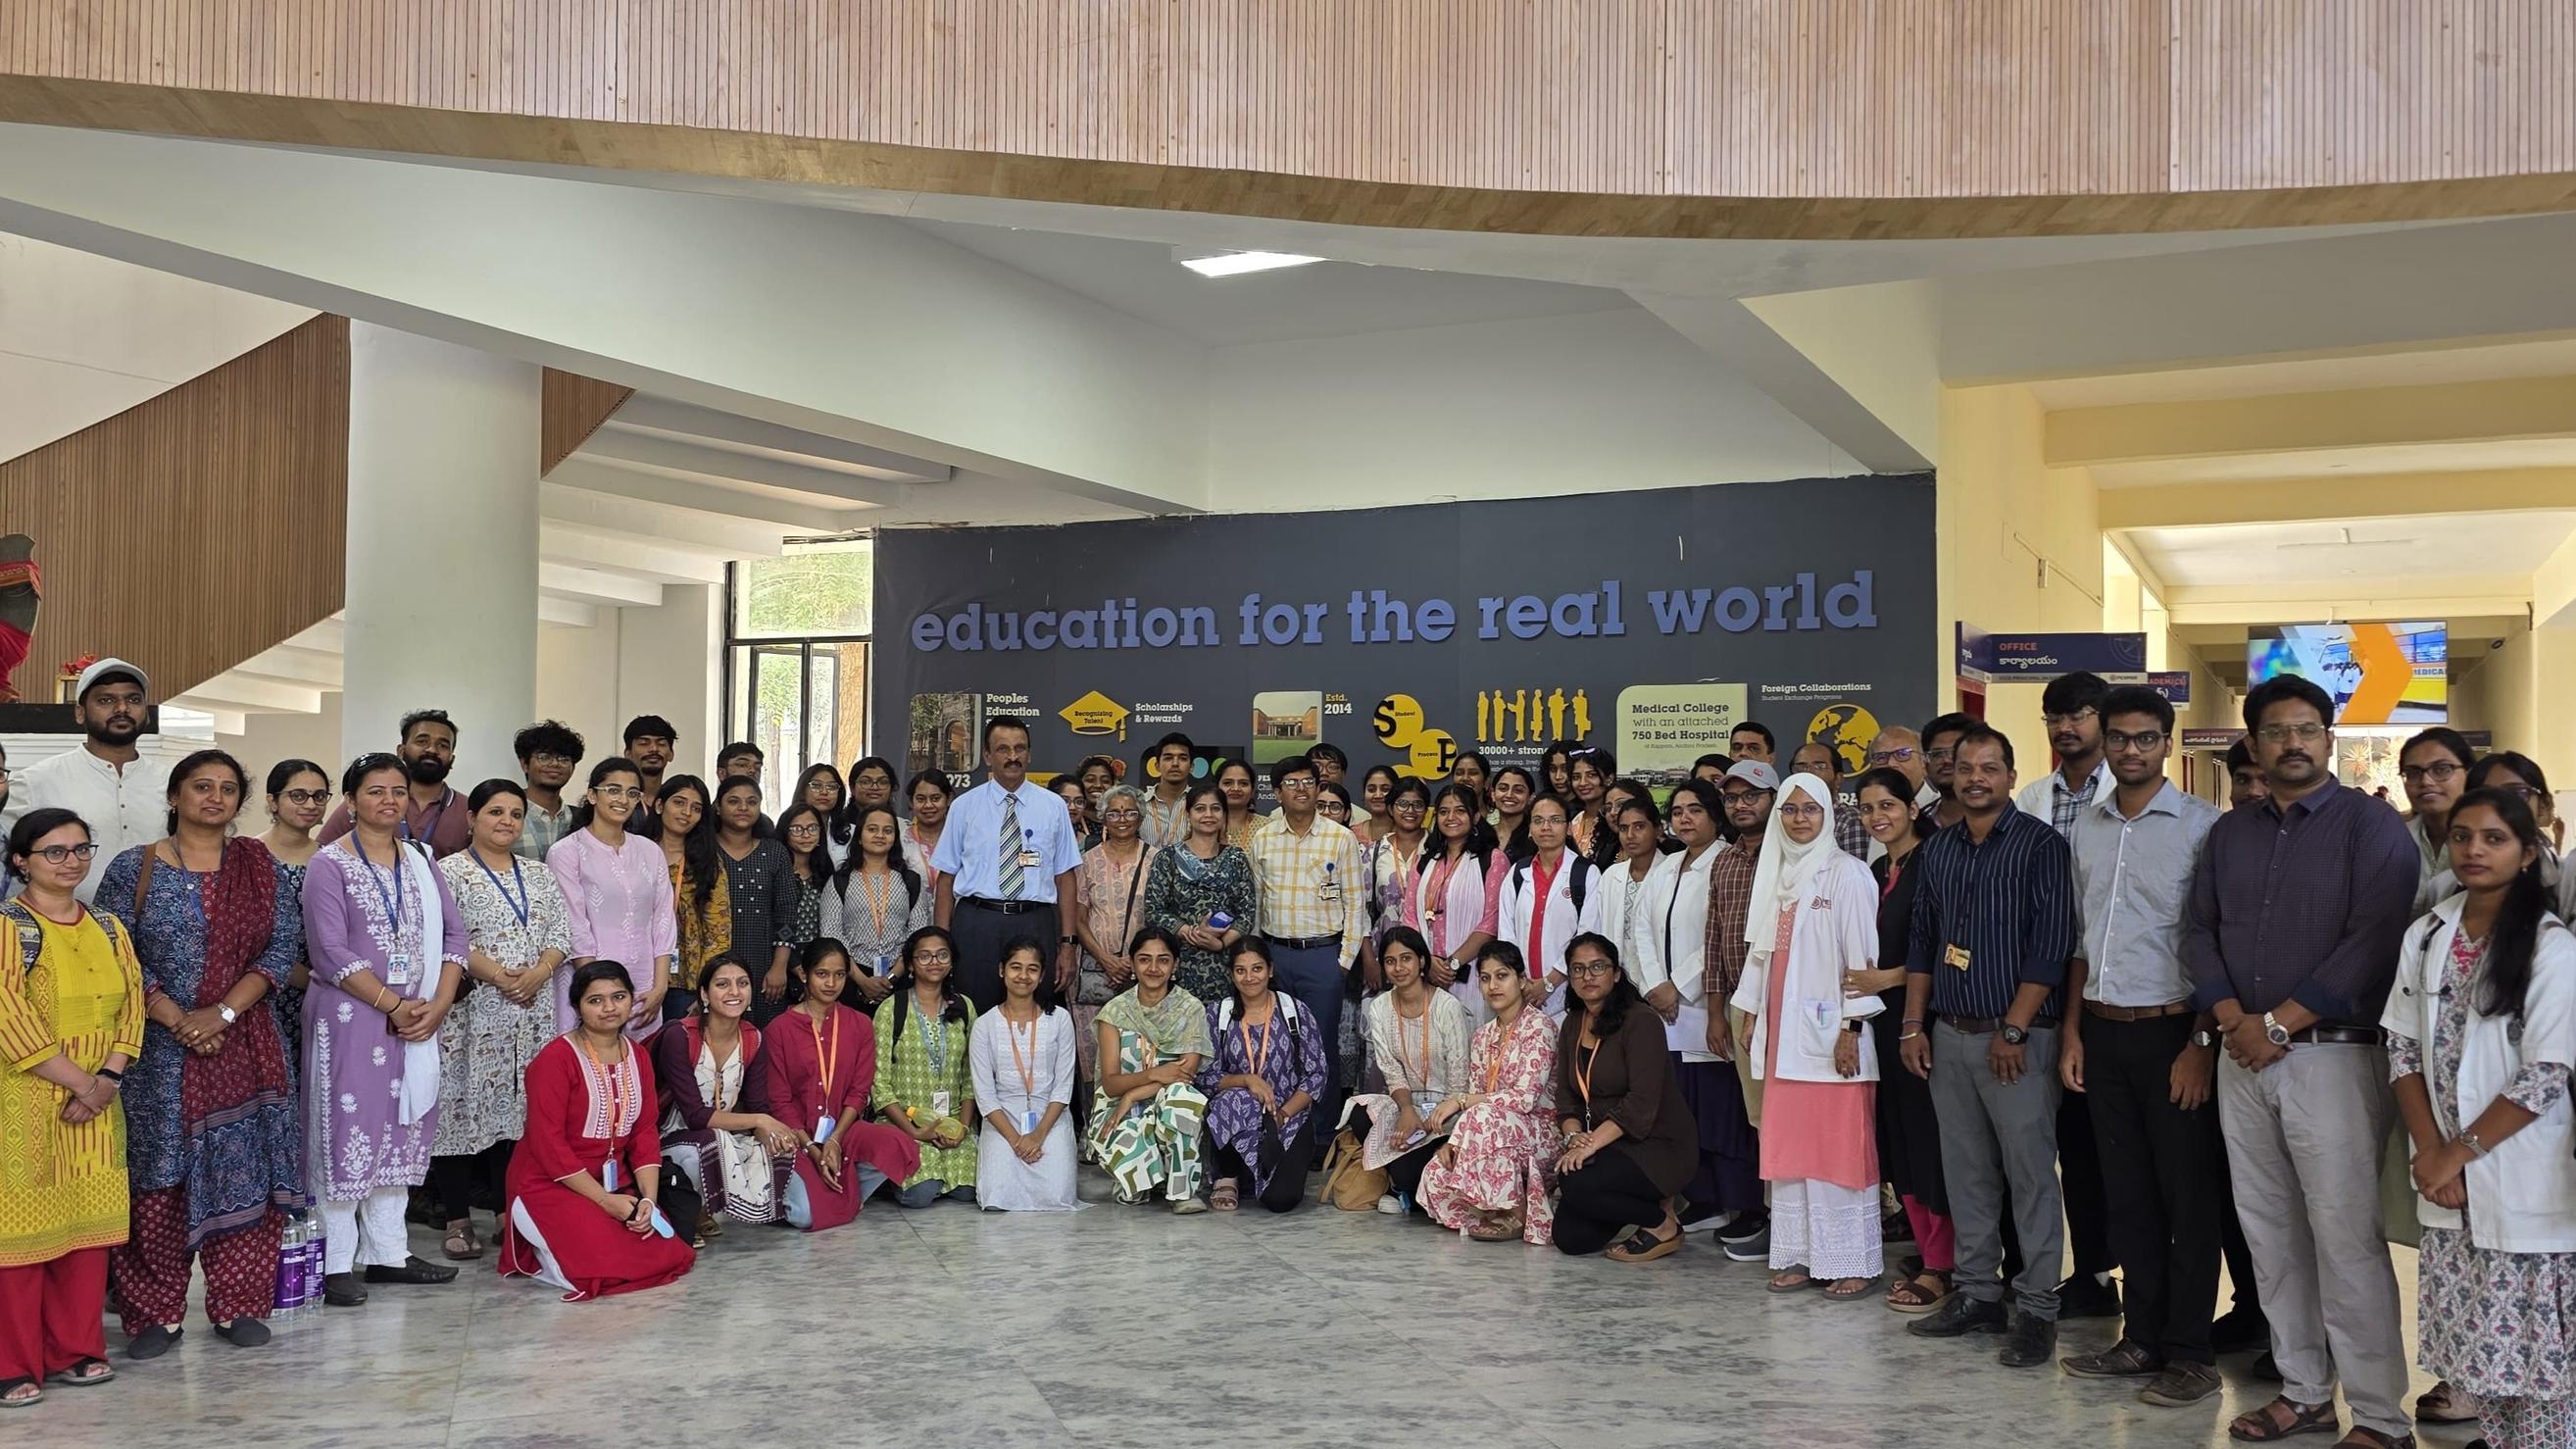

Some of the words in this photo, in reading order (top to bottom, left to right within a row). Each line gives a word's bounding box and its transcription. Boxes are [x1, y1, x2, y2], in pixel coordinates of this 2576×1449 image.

[911, 597, 1220, 652] education
[1238, 593, 1328, 646] for
[1347, 590, 1457, 644] the
[1478, 580, 1626, 639] real
[1647, 570, 1878, 634] world
[1999, 642, 2038, 651] OFFICE
[2413, 667, 2447, 675] EDICA
[1761, 684, 1798, 693] Foreign
[1800, 683, 1872, 692] Collaborations
[986, 693, 1029, 705] Peoples
[1325, 693, 1348, 702] Estd.
[986, 706, 1040, 717] Education
[1135, 702, 1194, 713] Scholarships
[1324, 703, 1353, 715] 2014
[1632, 705, 1680, 714] Medical
[1683, 704, 1729, 714] College
[1135, 715, 1142, 724] &
[1143, 714, 1183, 724] Rewards
[1373, 700, 1397, 737] S
[1633, 718, 1657, 727] with
[1678, 716, 1729, 726] attached
[1632, 731, 1653, 740] 750
[1655, 730, 1677, 740] Bed
[1680, 730, 1730, 741] Hospital
[1436, 737, 1458, 773] P
[1478, 746, 1515, 755] 30000+
